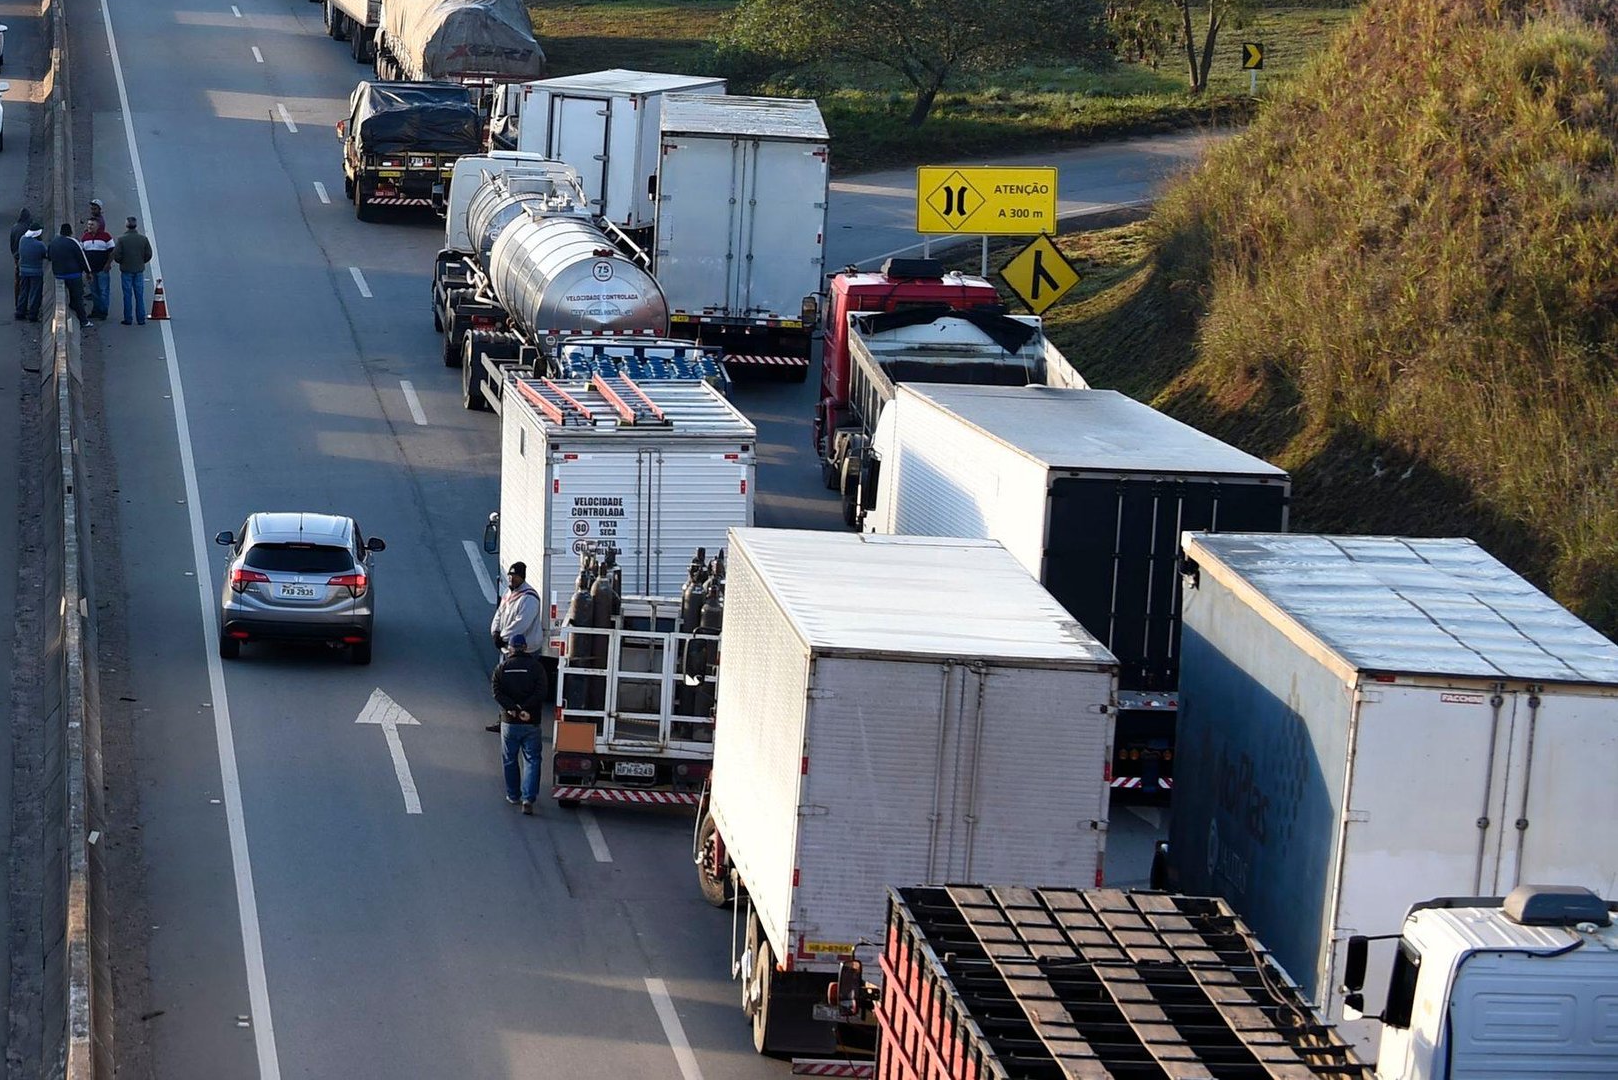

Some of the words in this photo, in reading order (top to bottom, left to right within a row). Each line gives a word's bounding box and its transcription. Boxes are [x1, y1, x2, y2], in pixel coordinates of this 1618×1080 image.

[994, 181, 1049, 196] ATENÇÃO
[998, 209, 1007, 218] A
[1010, 209, 1030, 218] 300
[597, 265, 610, 274] 75
[574, 497, 623, 506] VELOCIDADE
[571, 507, 625, 516] CONTROLADA
[575, 523, 587, 532] 80
[598, 520, 618, 528] PISTA
[599, 528, 617, 536] SECA
